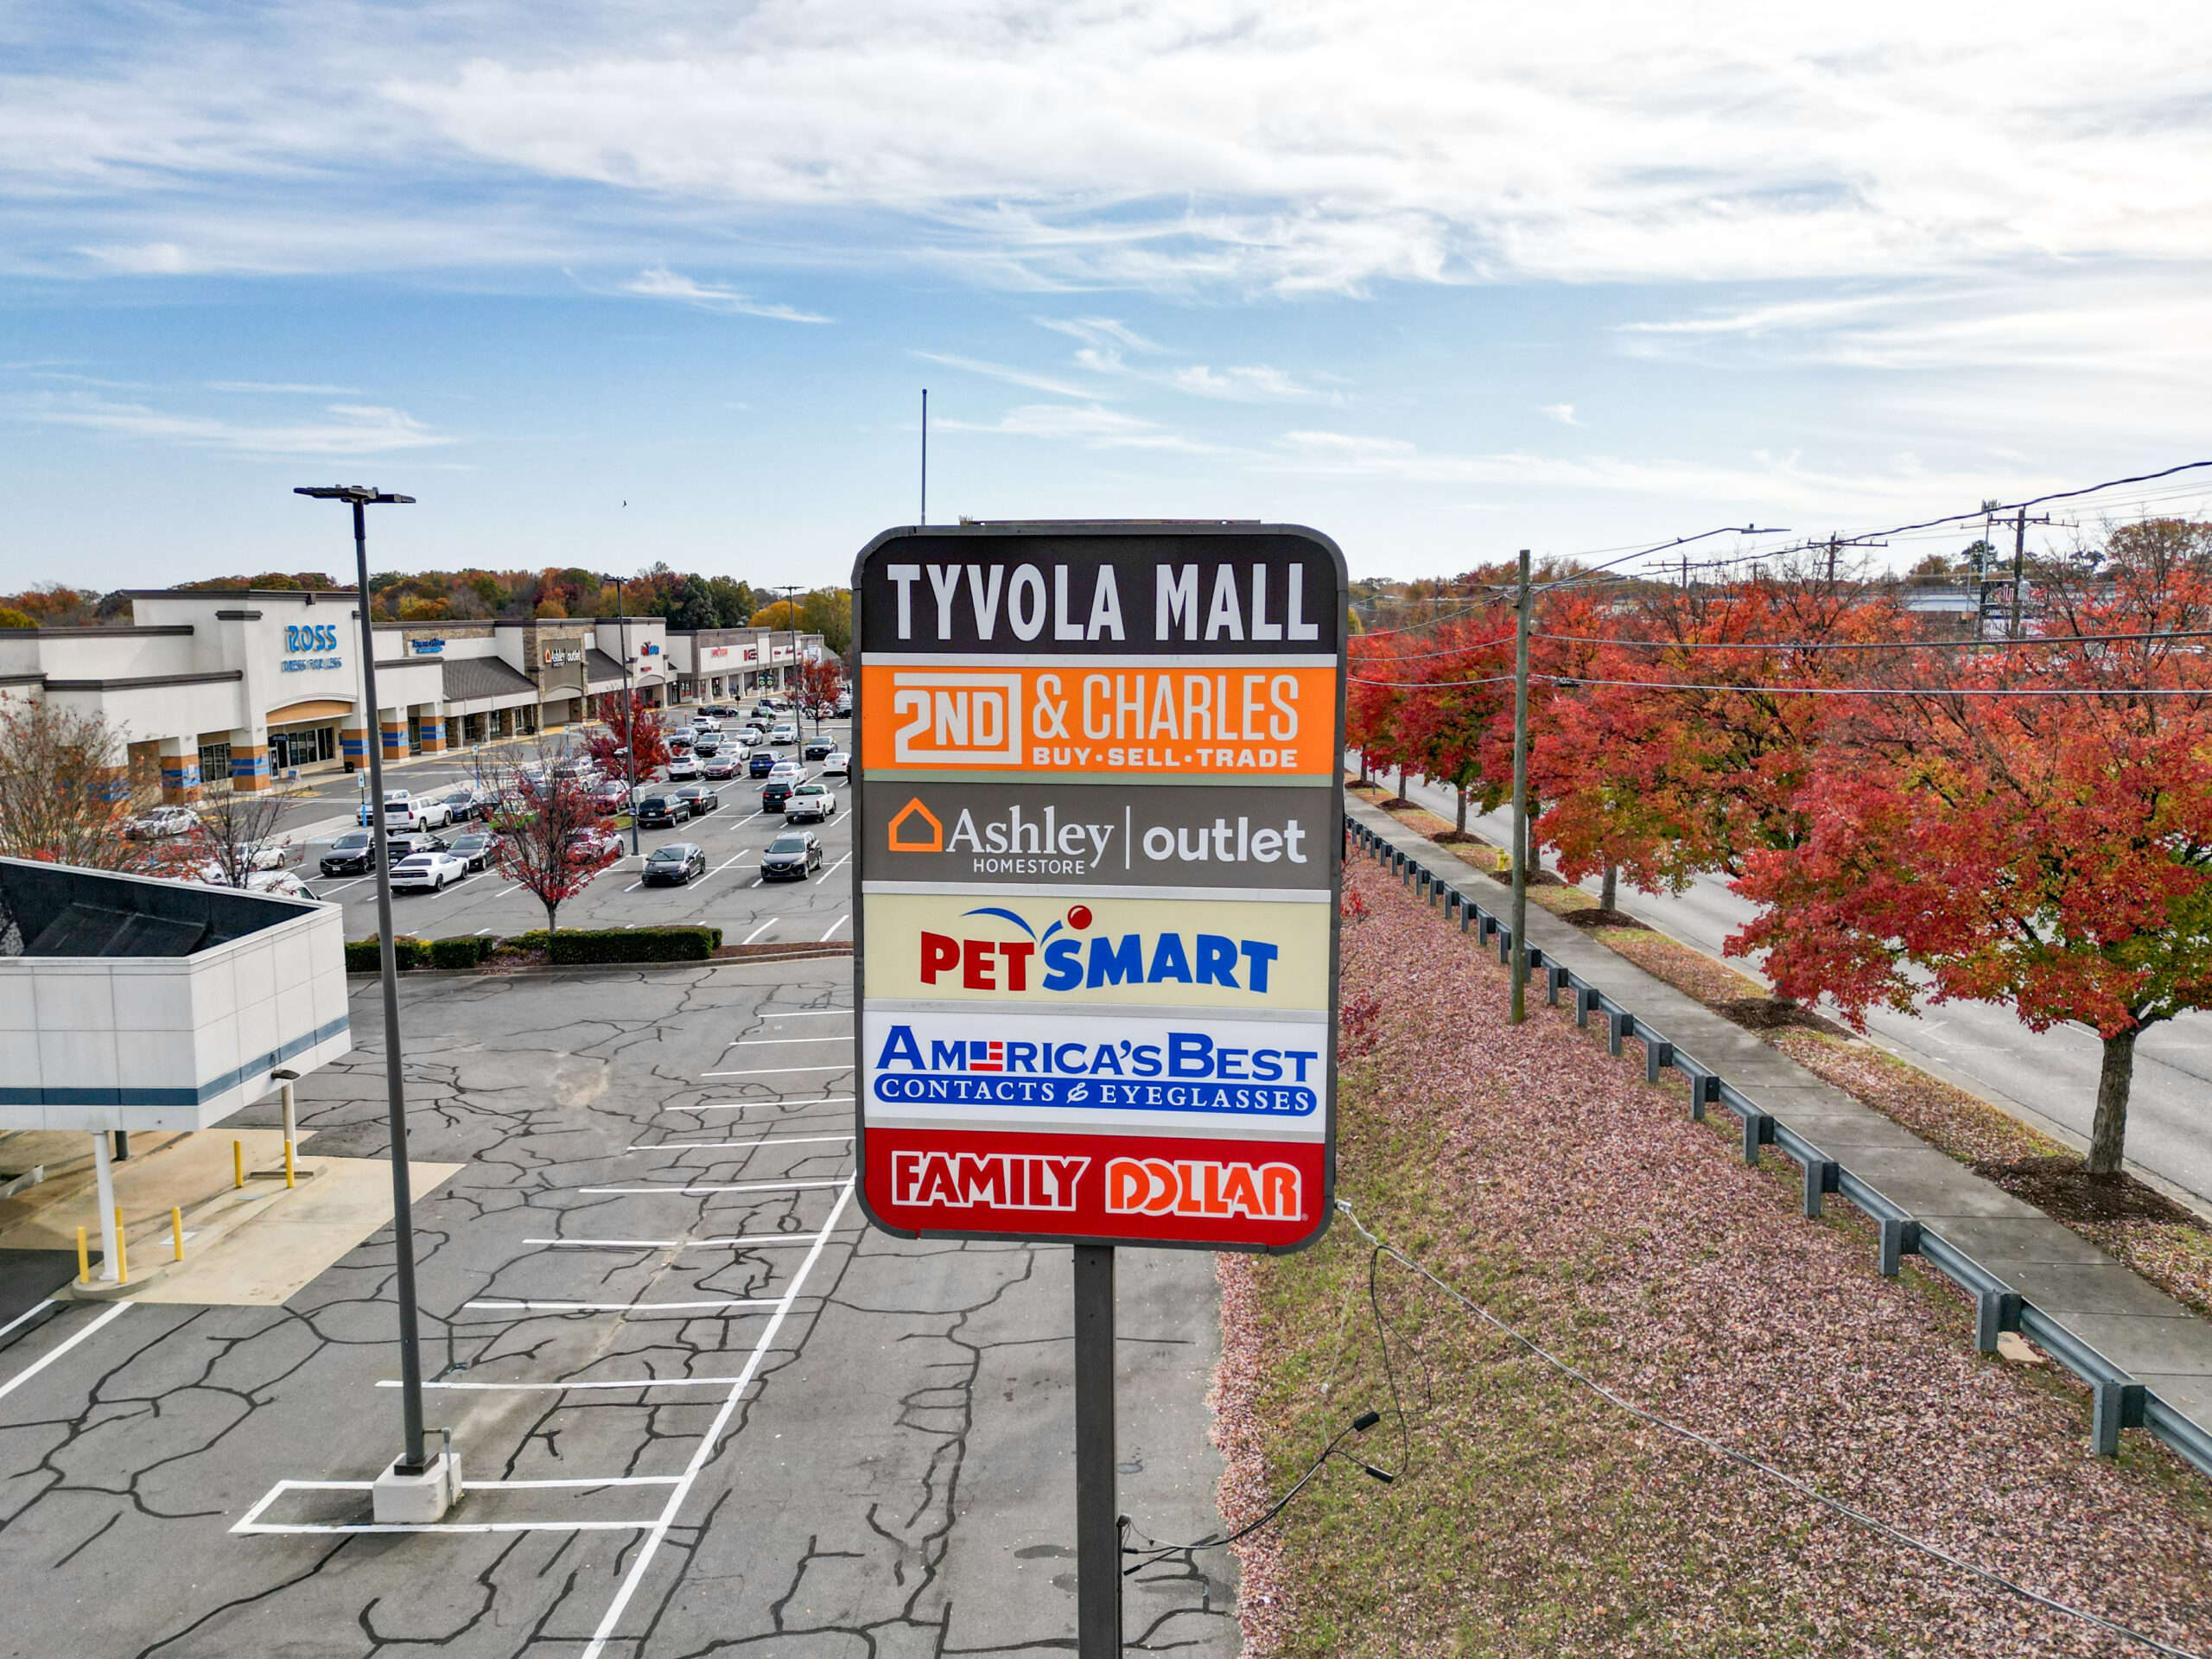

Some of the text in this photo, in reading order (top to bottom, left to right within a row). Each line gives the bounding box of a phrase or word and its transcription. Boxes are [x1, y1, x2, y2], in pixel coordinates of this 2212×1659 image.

[887, 563, 1319, 641] TYVOLA MALL
[287, 625, 337, 652] ROSS
[894, 674, 1299, 762] 2ND & CHARLES
[946, 804, 1307, 868] Ashley outlet
[973, 858, 1085, 874] HOMESTORE
[1167, 1033, 1319, 1083] BEST
[881, 1078, 1310, 1112] CONTACTS & EYEGLASSES
[892, 1151, 1301, 1221] FAMILY DOLLAR
